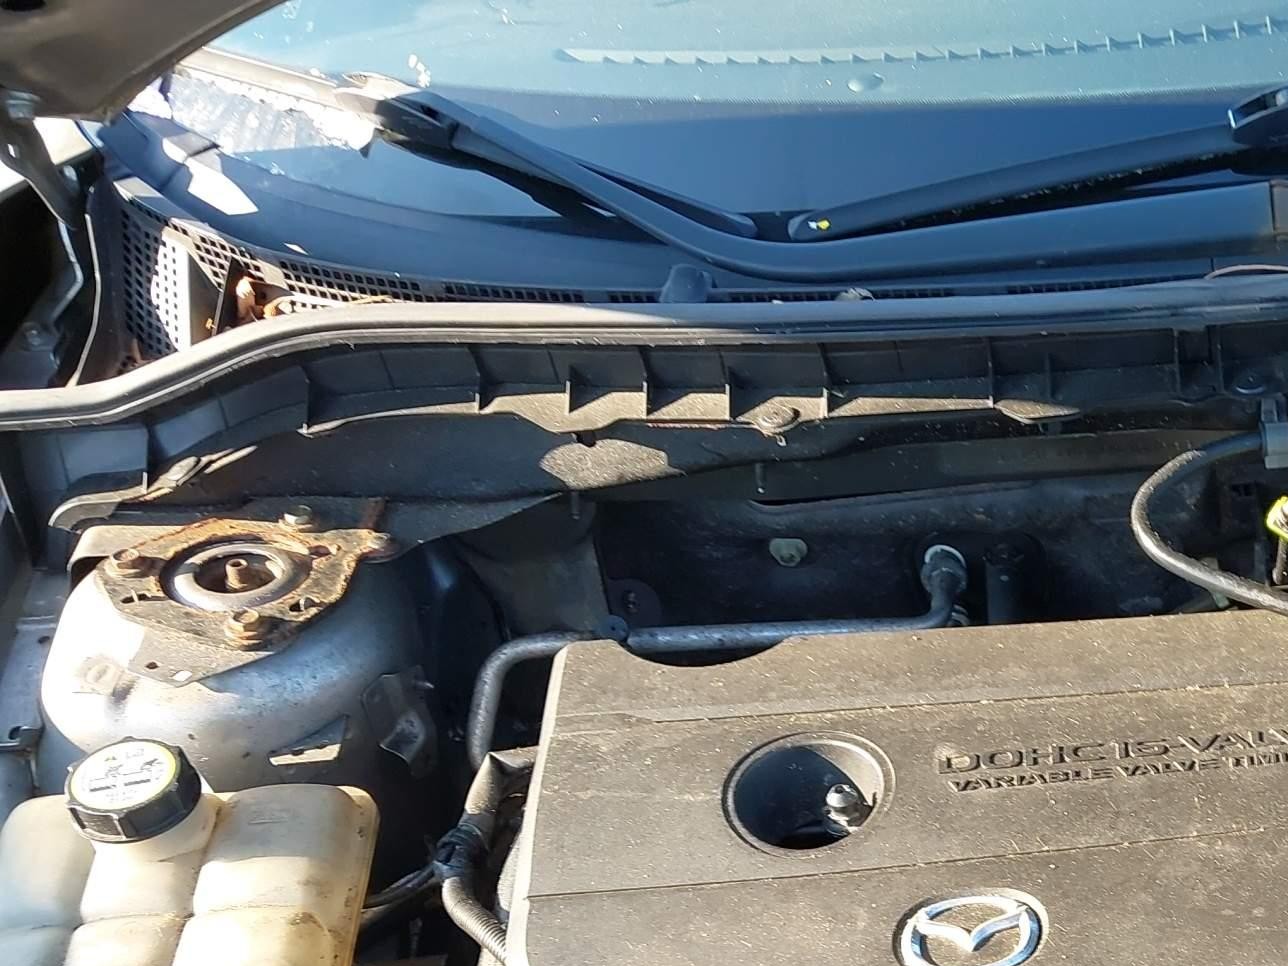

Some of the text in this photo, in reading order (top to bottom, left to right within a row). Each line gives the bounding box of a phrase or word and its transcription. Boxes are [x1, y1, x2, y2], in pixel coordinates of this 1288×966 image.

[938, 742, 1106, 774] DOHC
[948, 767, 1113, 792] VARIABLE
[1116, 758, 1221, 777] VALVE
